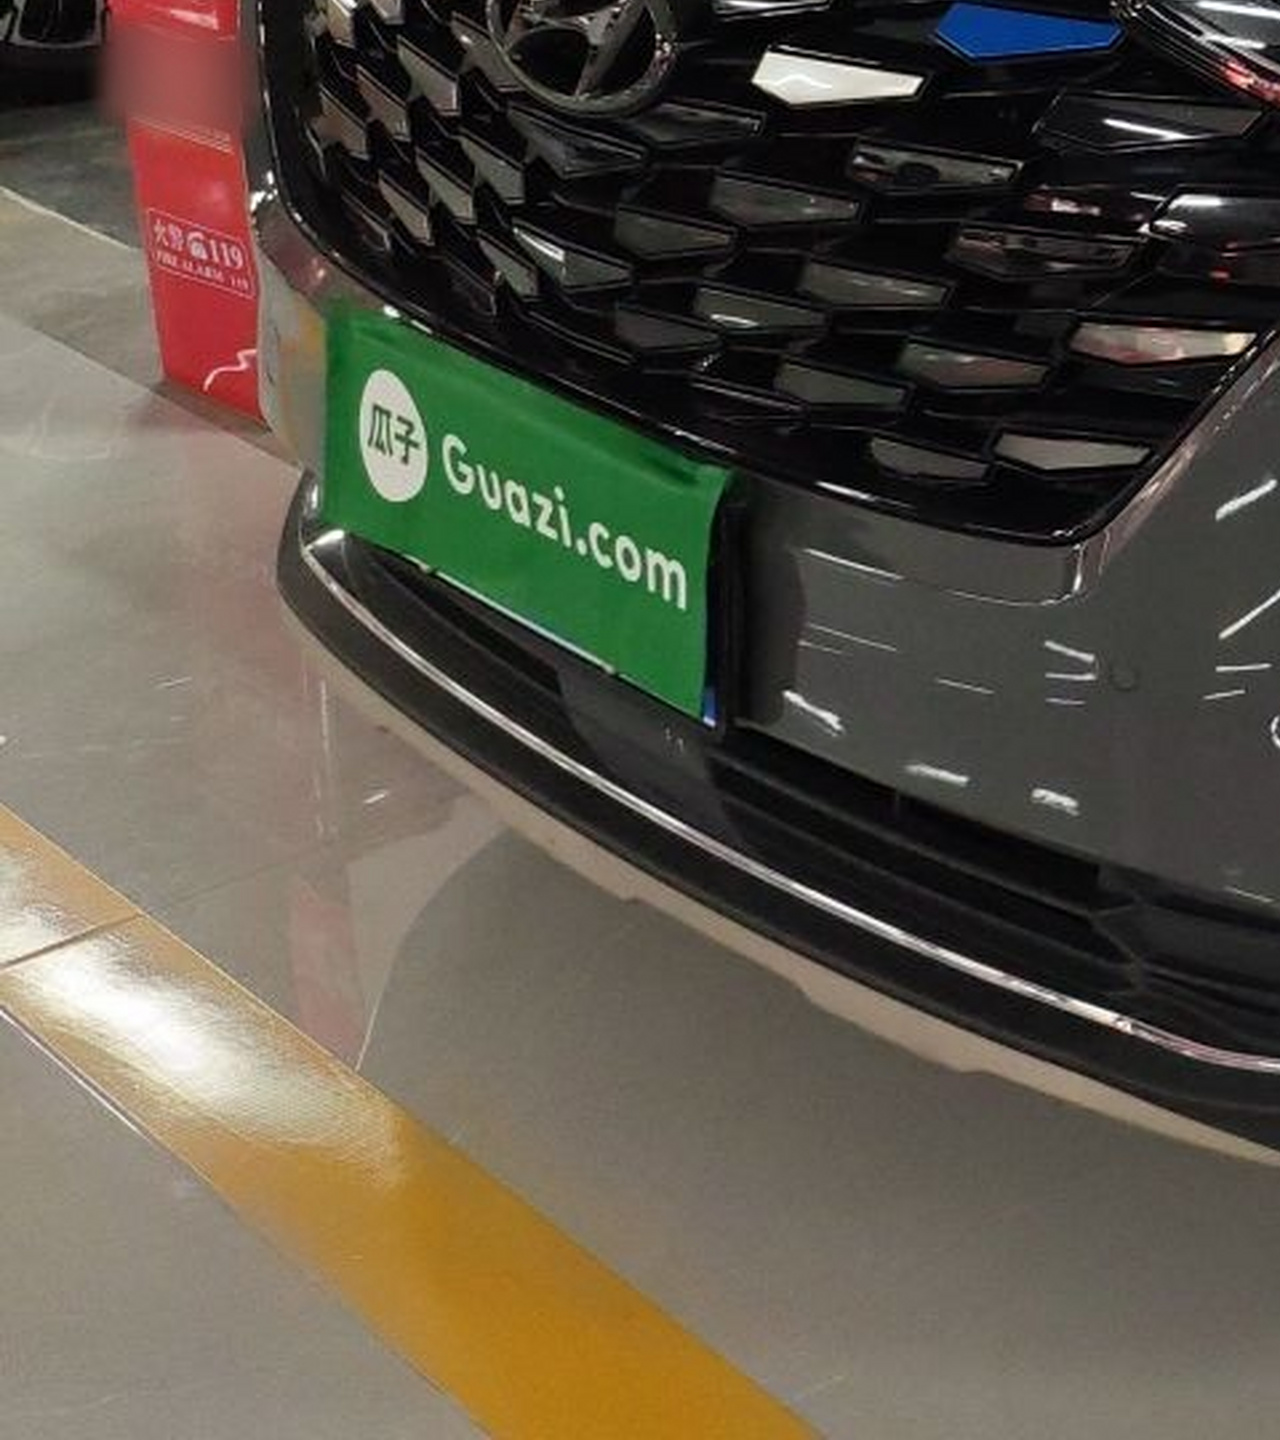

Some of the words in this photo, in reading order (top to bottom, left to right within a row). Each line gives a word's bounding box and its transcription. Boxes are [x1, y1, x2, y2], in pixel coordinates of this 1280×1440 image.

[209, 238, 245, 270] 119
[367, 404, 421, 465] 瓜子
[441, 433, 687, 611] Guazi.com
